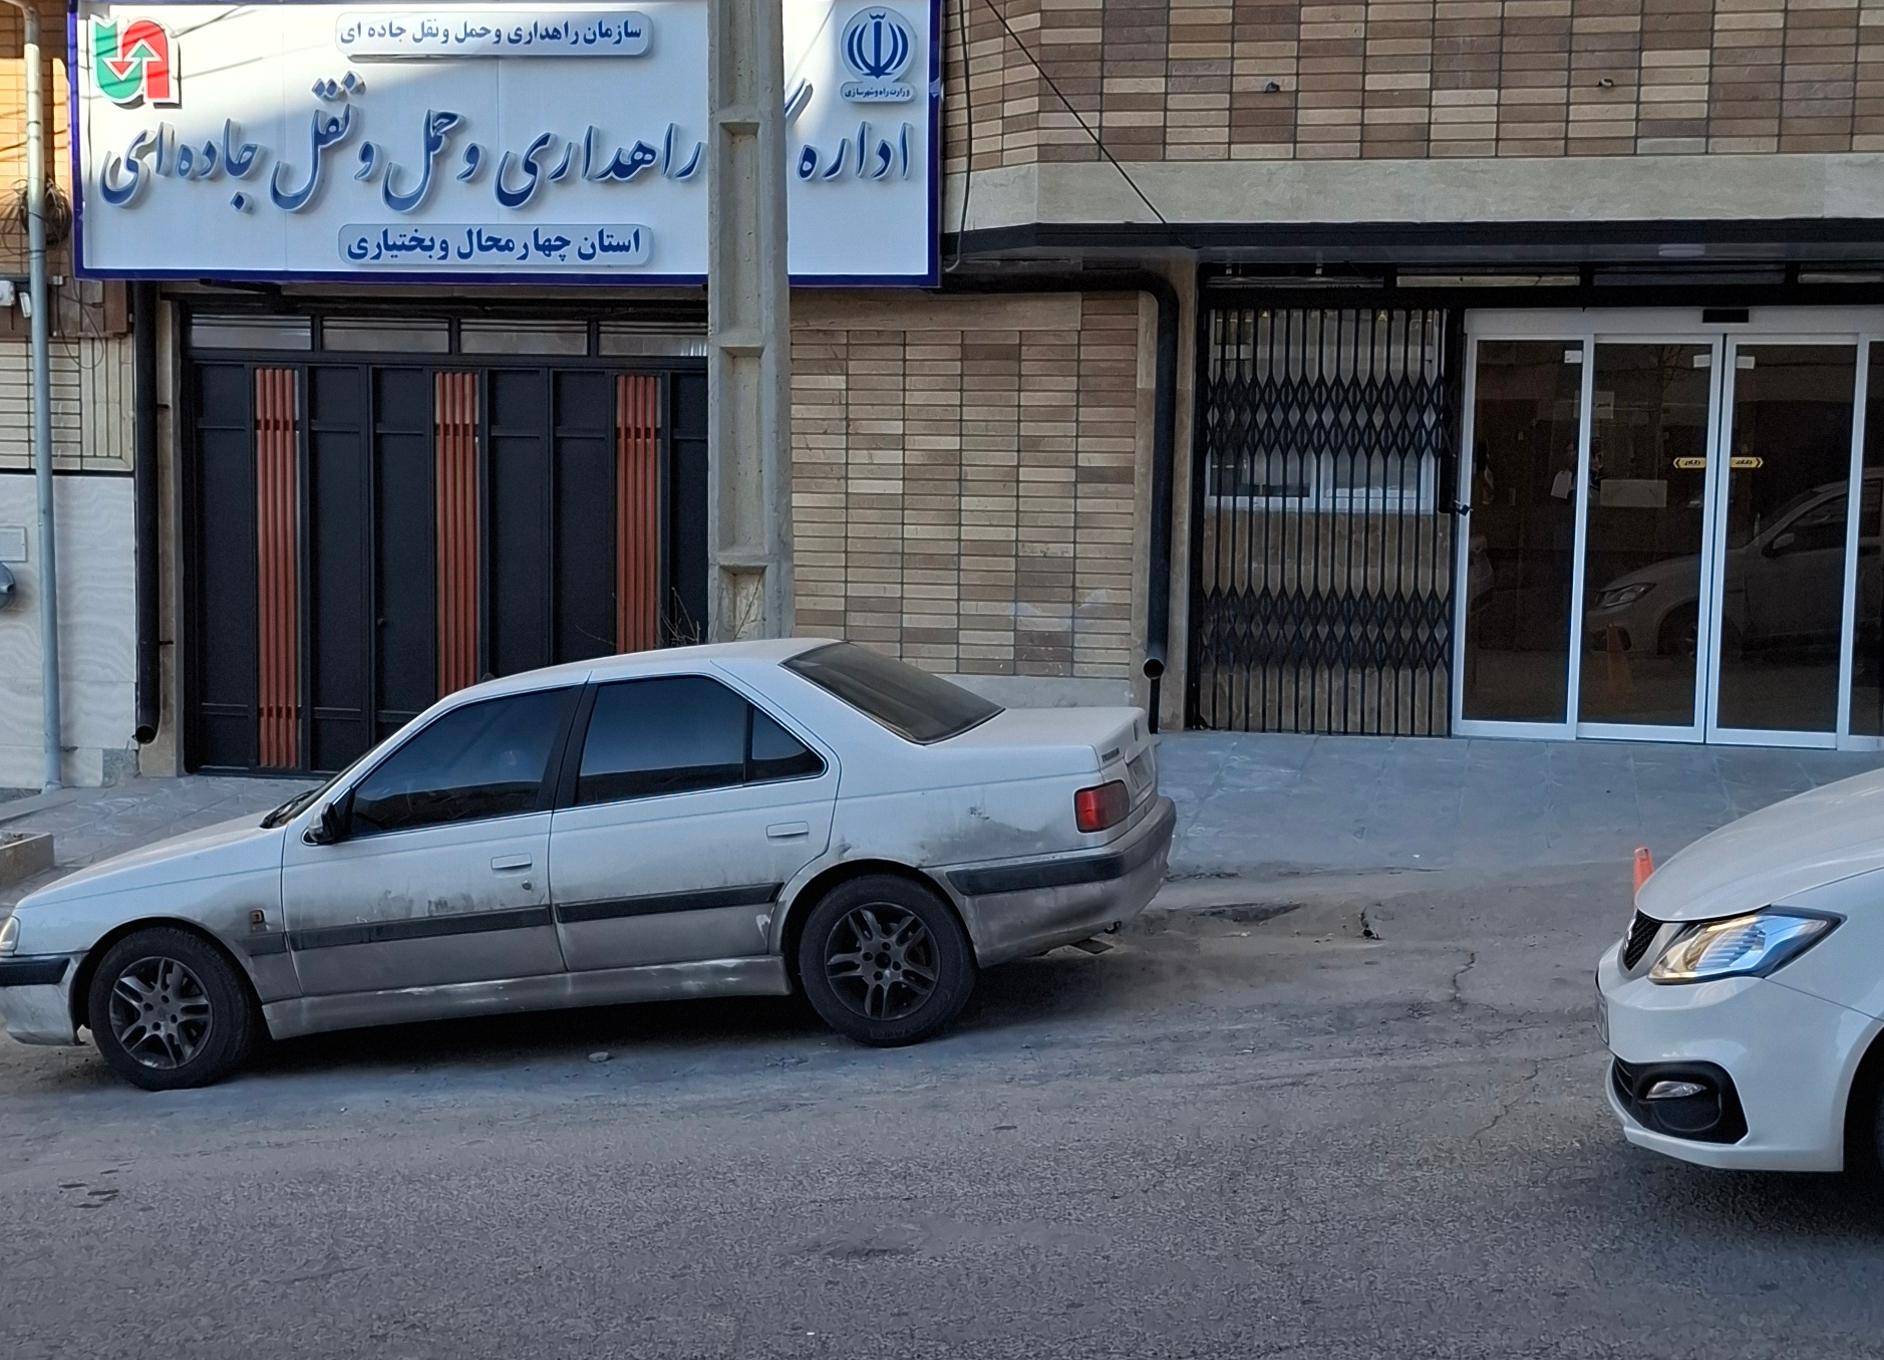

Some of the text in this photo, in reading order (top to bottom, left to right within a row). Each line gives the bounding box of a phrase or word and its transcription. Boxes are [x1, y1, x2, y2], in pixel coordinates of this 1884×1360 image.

[340, 20, 363, 44] ای
[366, 20, 407, 43] جاده
[506, 21, 579, 45] راهداری
[583, 19, 642, 45] سازمان
[269, 70, 364, 213] نقل
[797, 120, 911, 181] اداره
[381, 109, 464, 214] حمل
[494, 122, 704, 209] راهداری
[577, 227, 641, 260] استان
